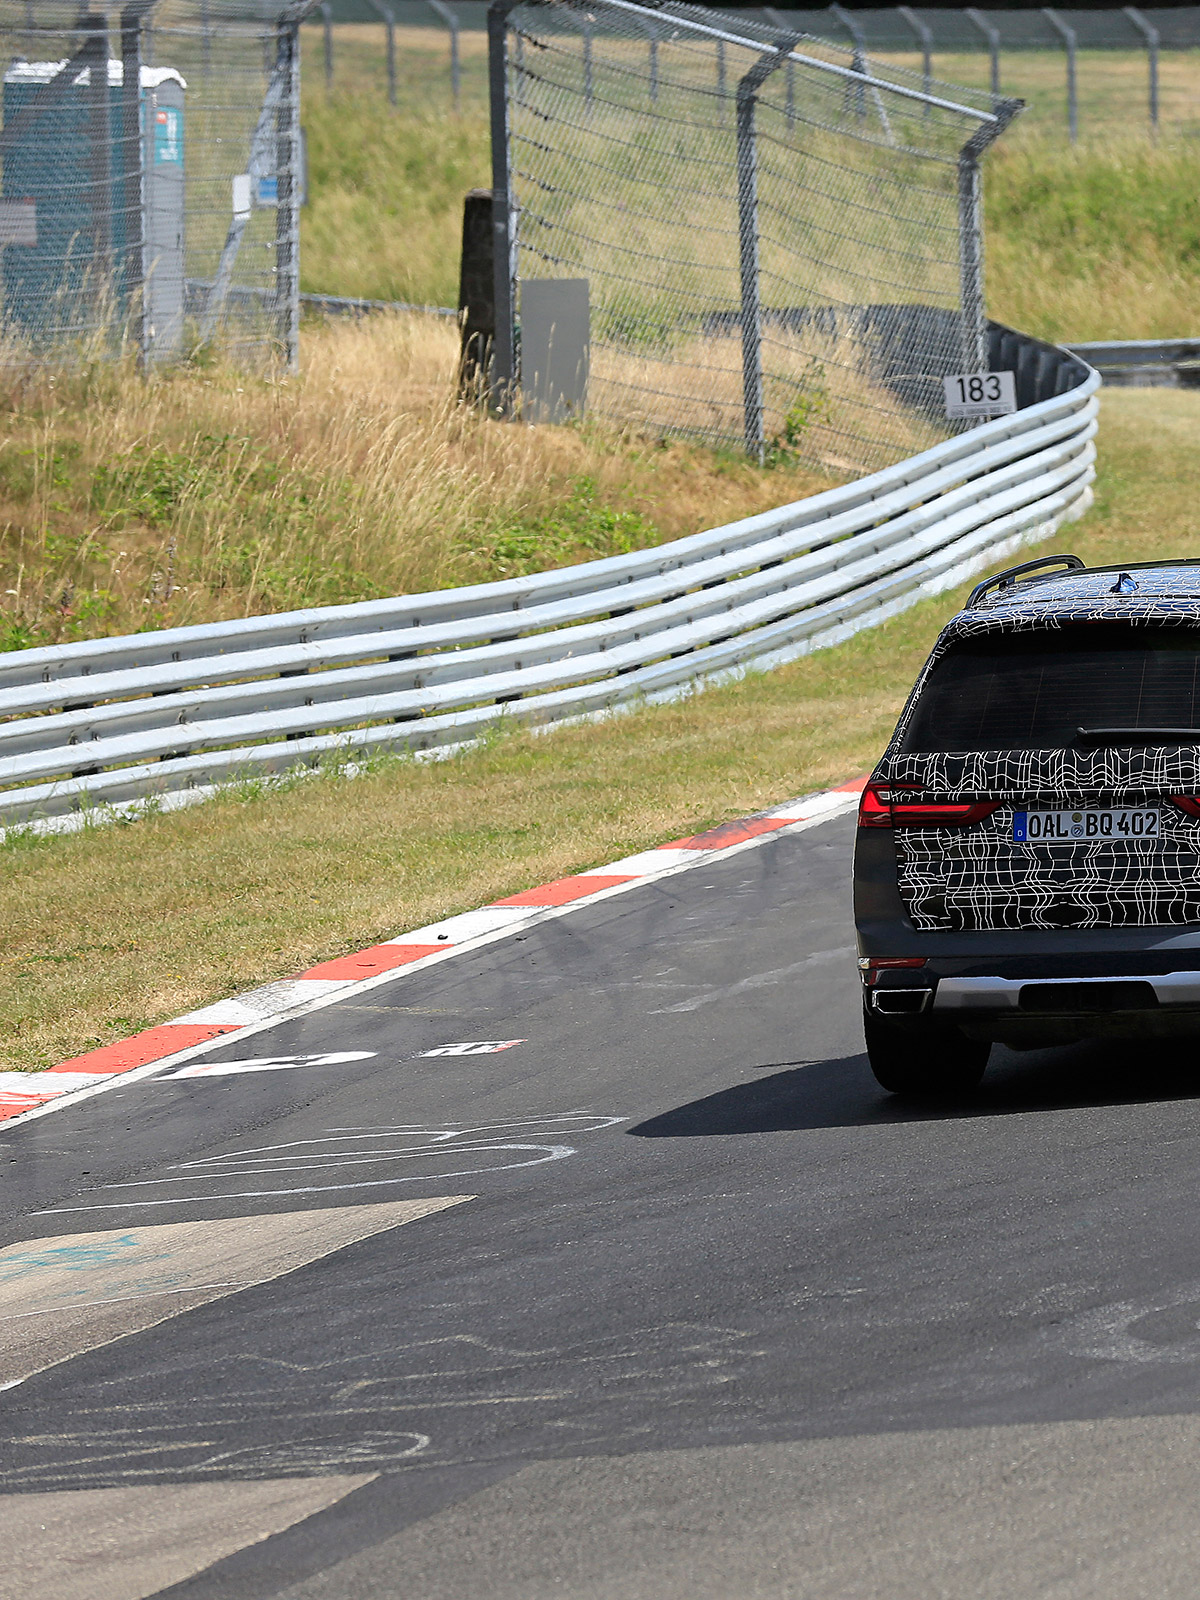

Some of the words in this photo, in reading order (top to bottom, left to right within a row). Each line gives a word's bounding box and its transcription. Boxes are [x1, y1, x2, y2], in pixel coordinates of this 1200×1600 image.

[957, 375, 1001, 403] 183
[1017, 829, 1023, 837] D
[1028, 814, 1068, 839] OAL
[1085, 813, 1113, 838] BQ
[1116, 812, 1157, 836] 402
